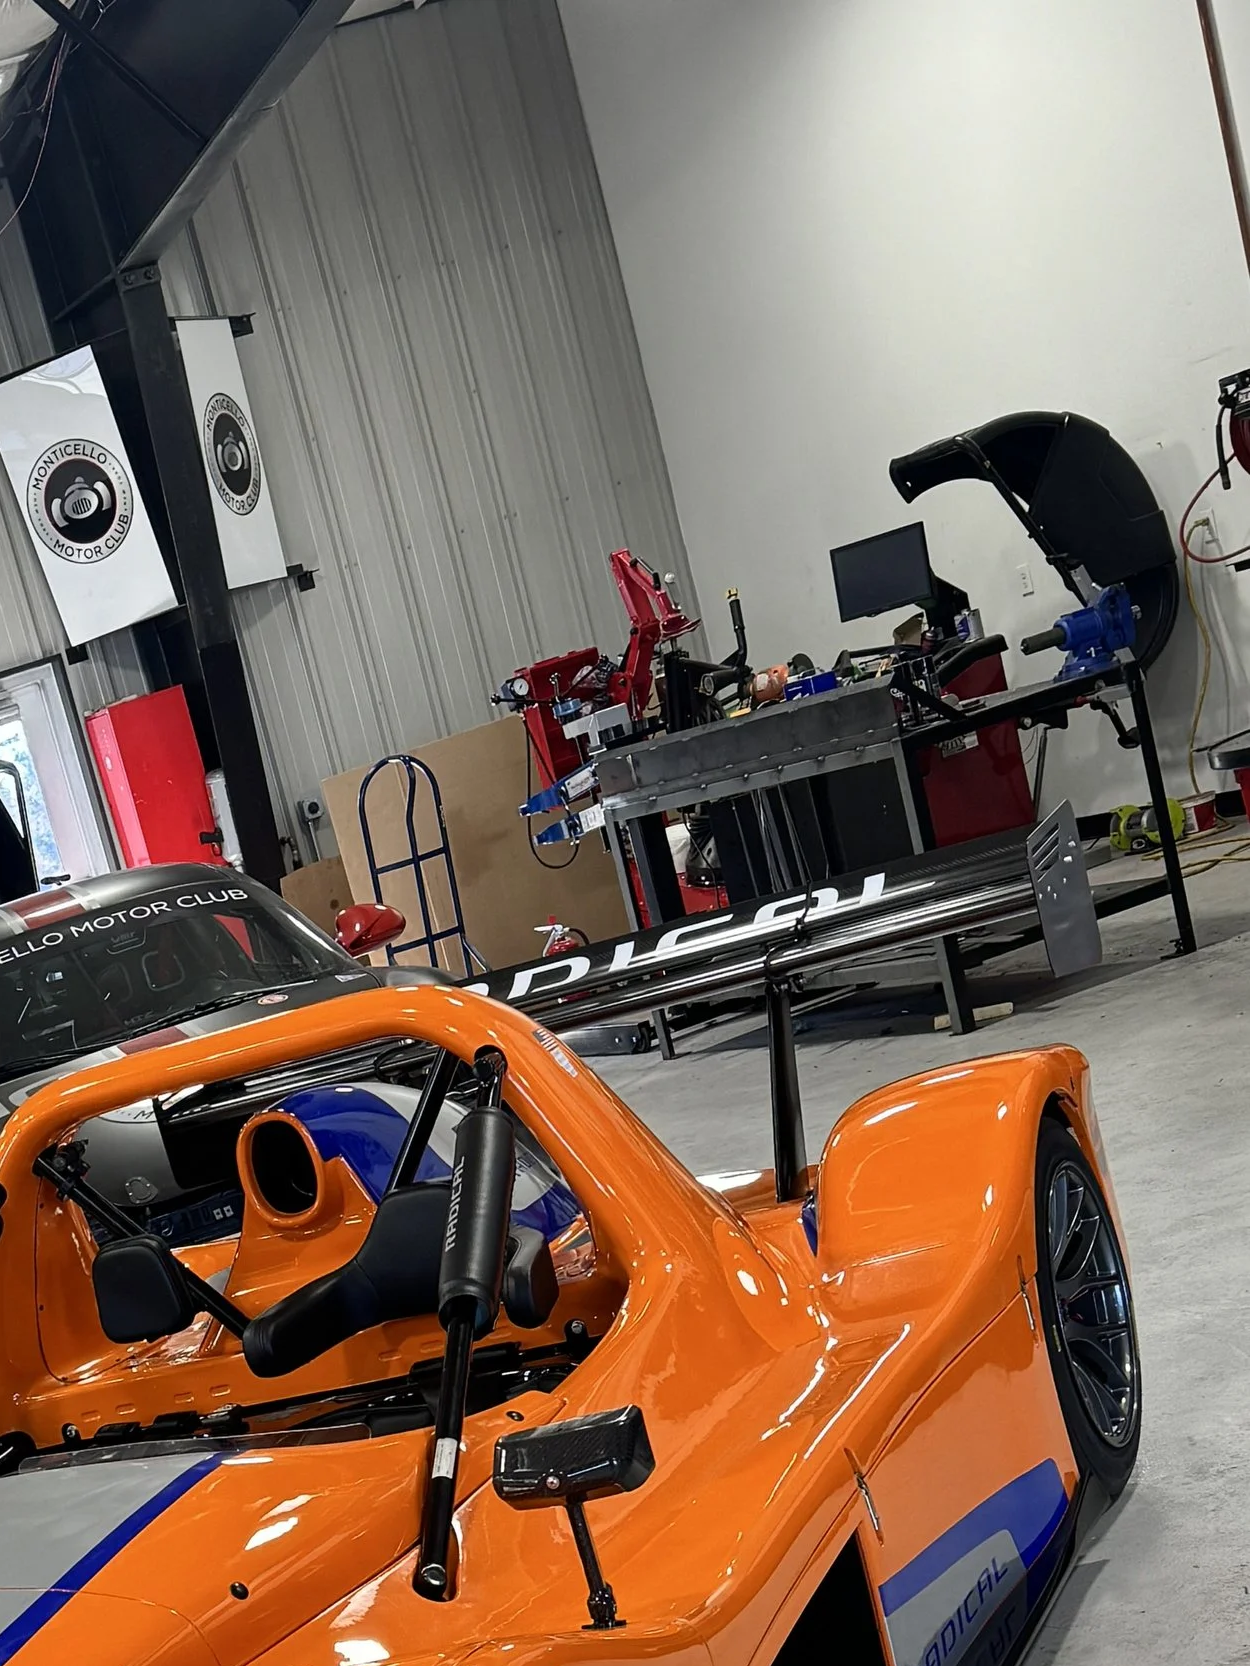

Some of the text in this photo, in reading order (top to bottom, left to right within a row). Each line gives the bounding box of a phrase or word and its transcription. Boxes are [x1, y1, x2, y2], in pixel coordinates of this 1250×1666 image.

[206, 398, 246, 431] MONTICELLO
[32, 444, 108, 491] MONTICELLO
[53, 513, 130, 560] MOTOR CLUB
[69, 900, 173, 938] MOTOR
[175, 888, 249, 910] CLUB
[444, 1155, 465, 1253] RADICAL
